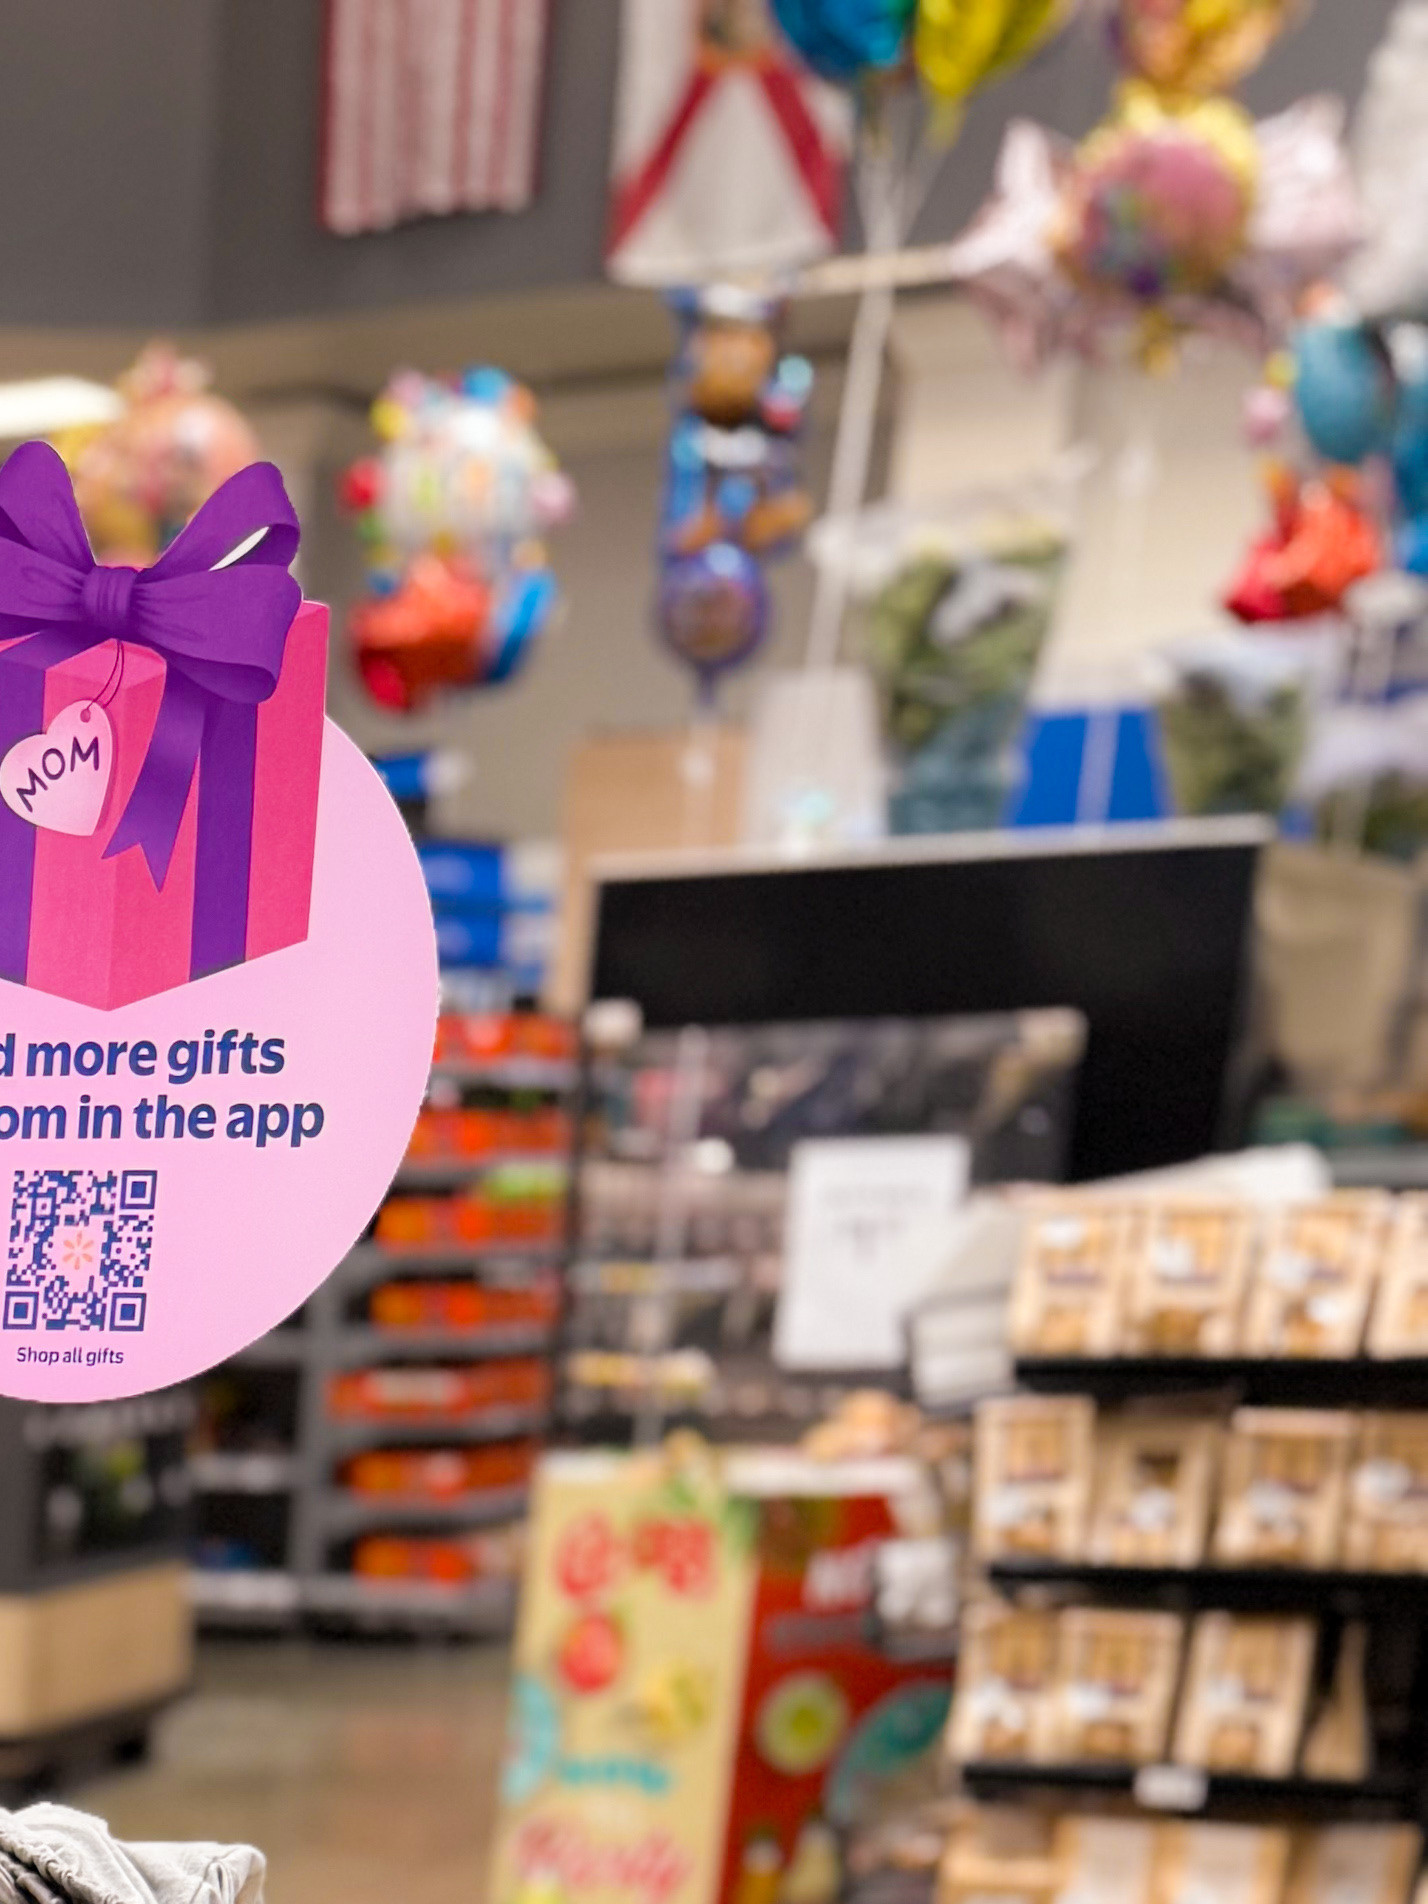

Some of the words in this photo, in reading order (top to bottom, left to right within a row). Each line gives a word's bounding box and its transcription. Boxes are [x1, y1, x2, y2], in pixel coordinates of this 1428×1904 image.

[16, 736, 99, 812] MOM
[26, 1038, 157, 1077] more
[167, 1030, 286, 1084] gifts
[78, 1095, 122, 1139] in
[134, 1095, 216, 1139] the
[226, 1101, 324, 1147] app
[16, 1347, 60, 1366] Shop
[63, 1346, 83, 1364] all
[86, 1346, 125, 1367] gifts
